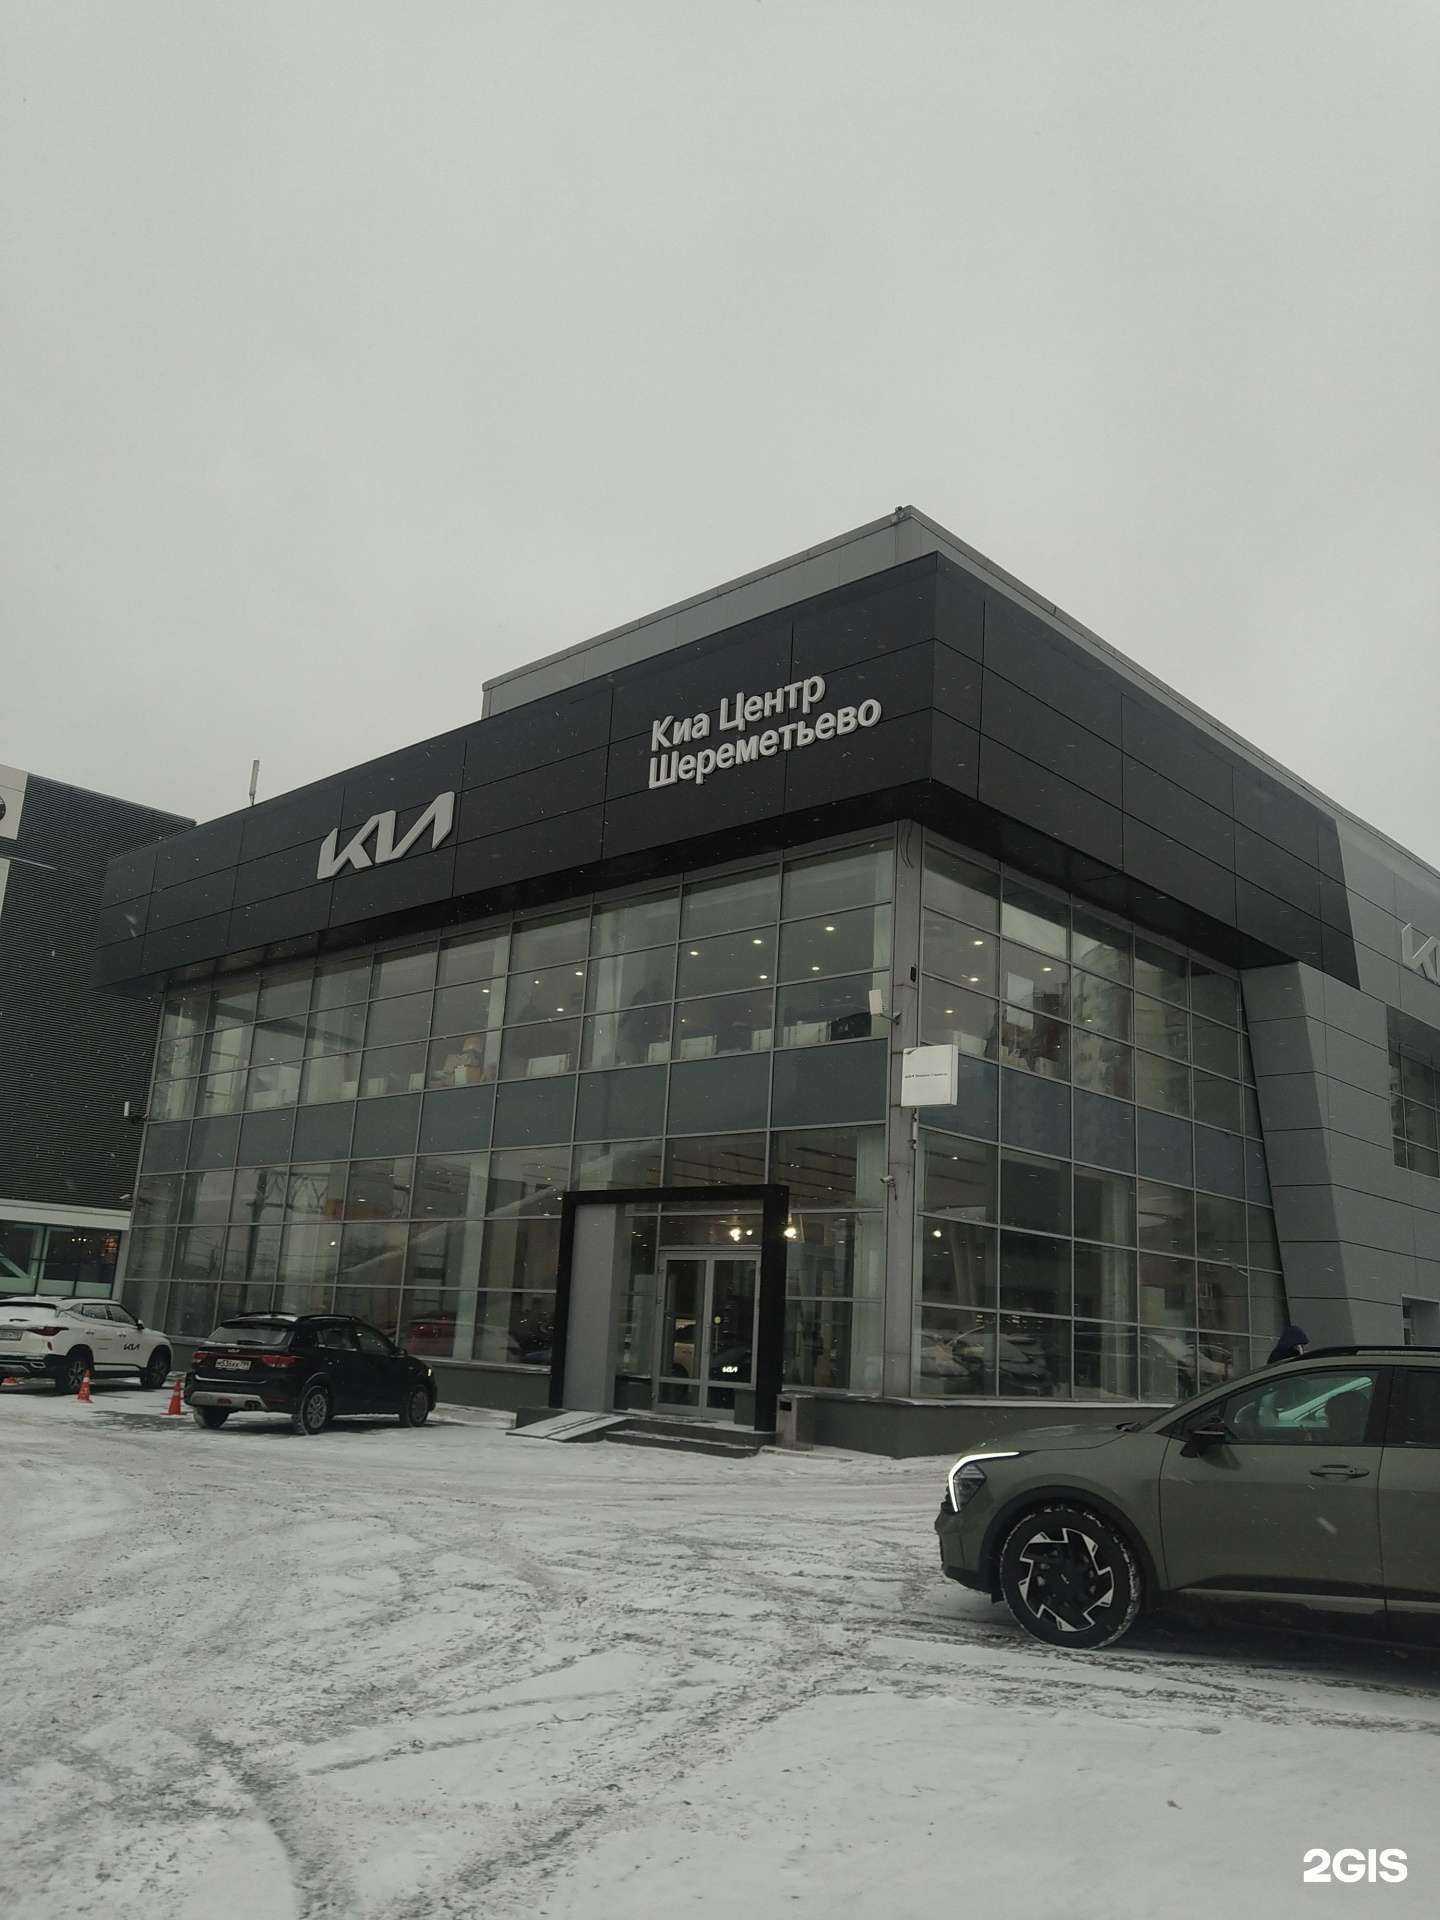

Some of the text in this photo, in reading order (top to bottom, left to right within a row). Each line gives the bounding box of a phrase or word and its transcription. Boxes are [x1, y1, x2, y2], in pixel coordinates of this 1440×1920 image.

[648, 698, 882, 789] Шереметьево
[651, 675, 826, 751] Киа Центр
[316, 791, 455, 880] KIA
[123, 1343, 141, 1351] KIA
